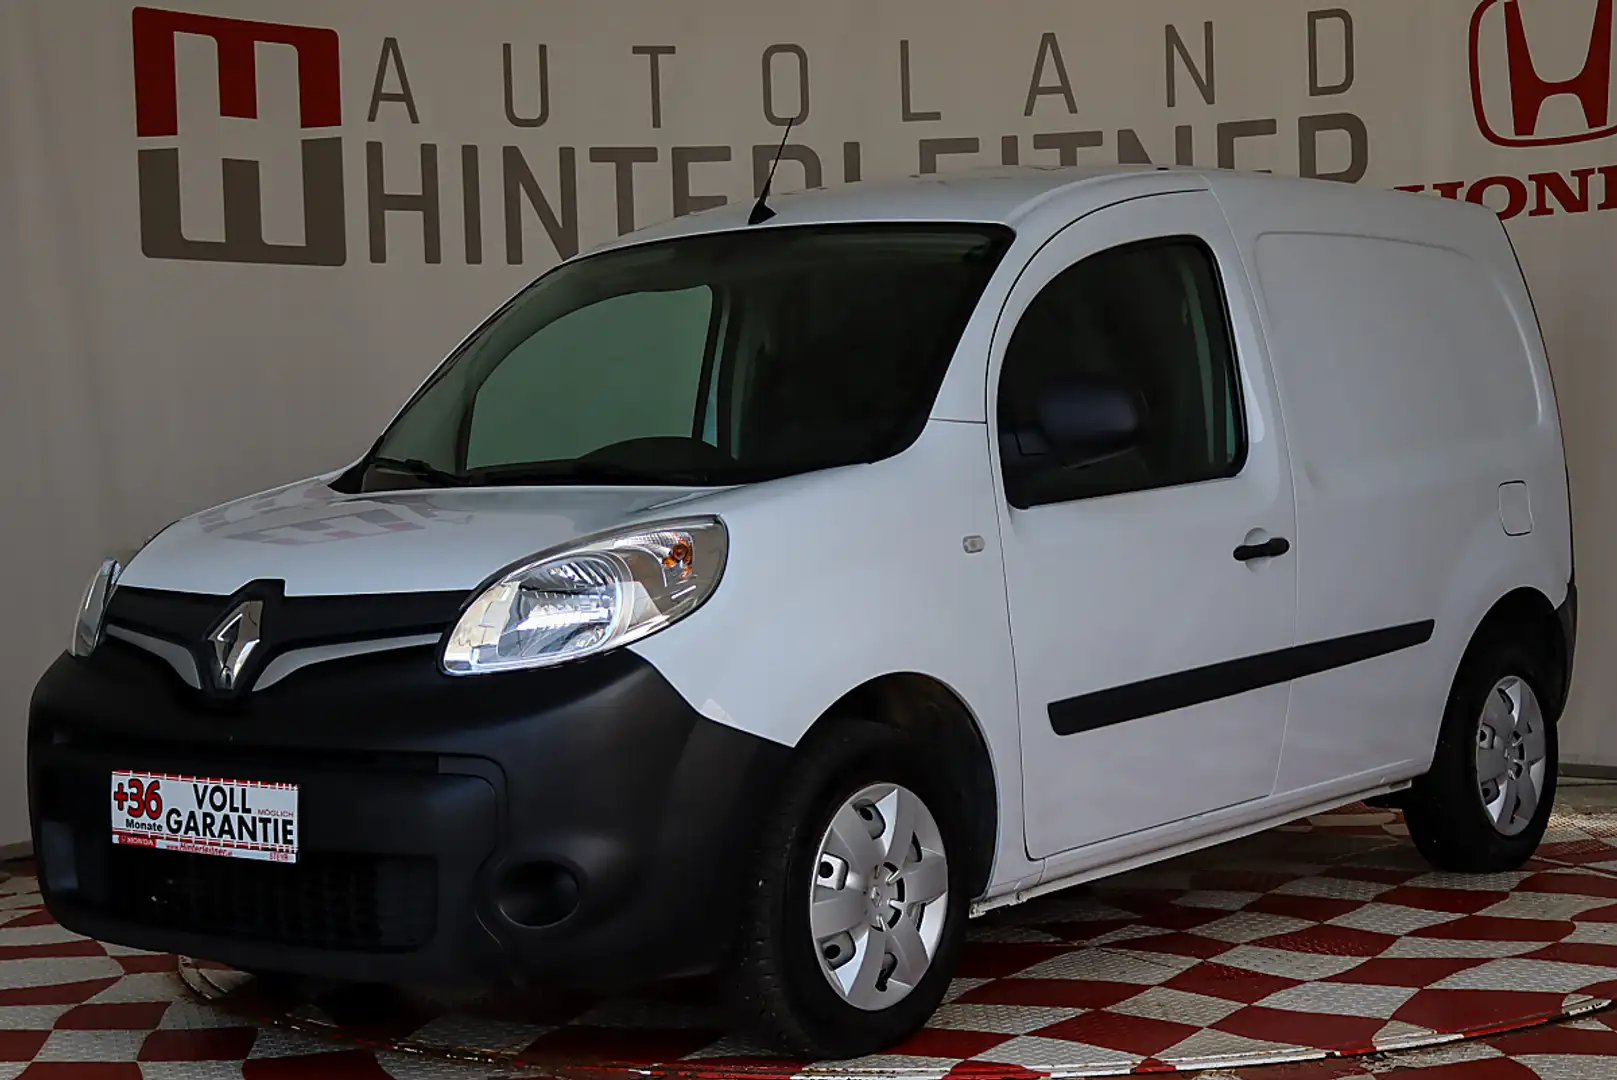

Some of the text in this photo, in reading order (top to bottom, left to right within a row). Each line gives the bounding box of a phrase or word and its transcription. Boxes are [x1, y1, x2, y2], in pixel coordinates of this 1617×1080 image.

[113, 778, 163, 820] +36
[192, 783, 252, 814] VOLL
[257, 808, 294, 818] MÖGLICH
[125, 818, 163, 832] Monate
[165, 807, 294, 846] GARANTIE
